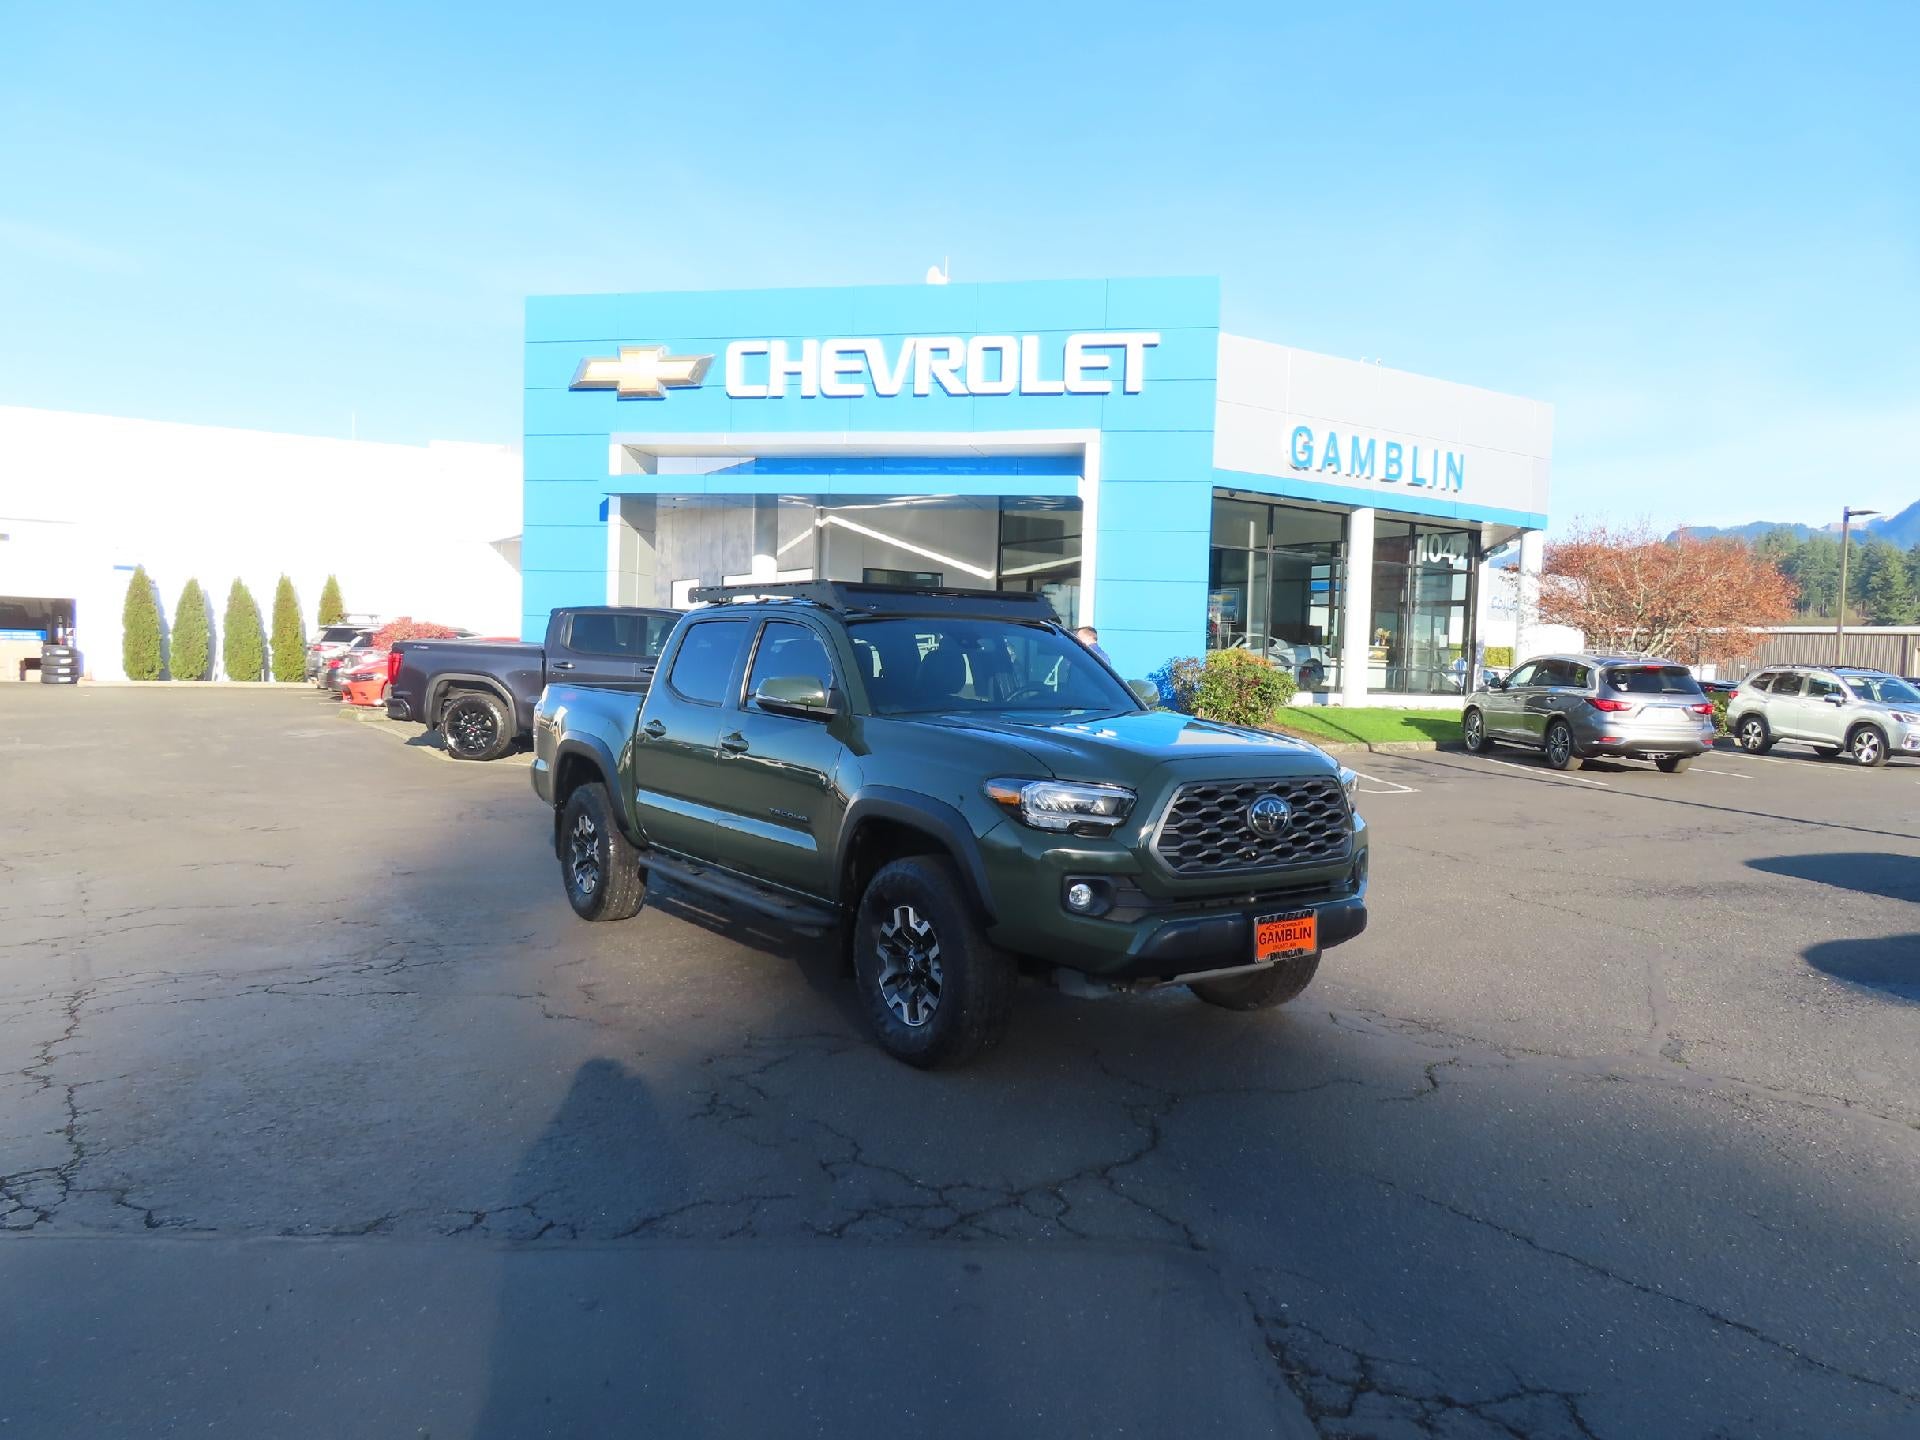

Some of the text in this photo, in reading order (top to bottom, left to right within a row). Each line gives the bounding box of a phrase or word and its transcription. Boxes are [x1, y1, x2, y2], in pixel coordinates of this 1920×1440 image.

[725, 331, 1160, 398] CHEVROLET
[1290, 425, 1465, 492] GAMBLIN
[1258, 926, 1312, 945] GAMBLIN
